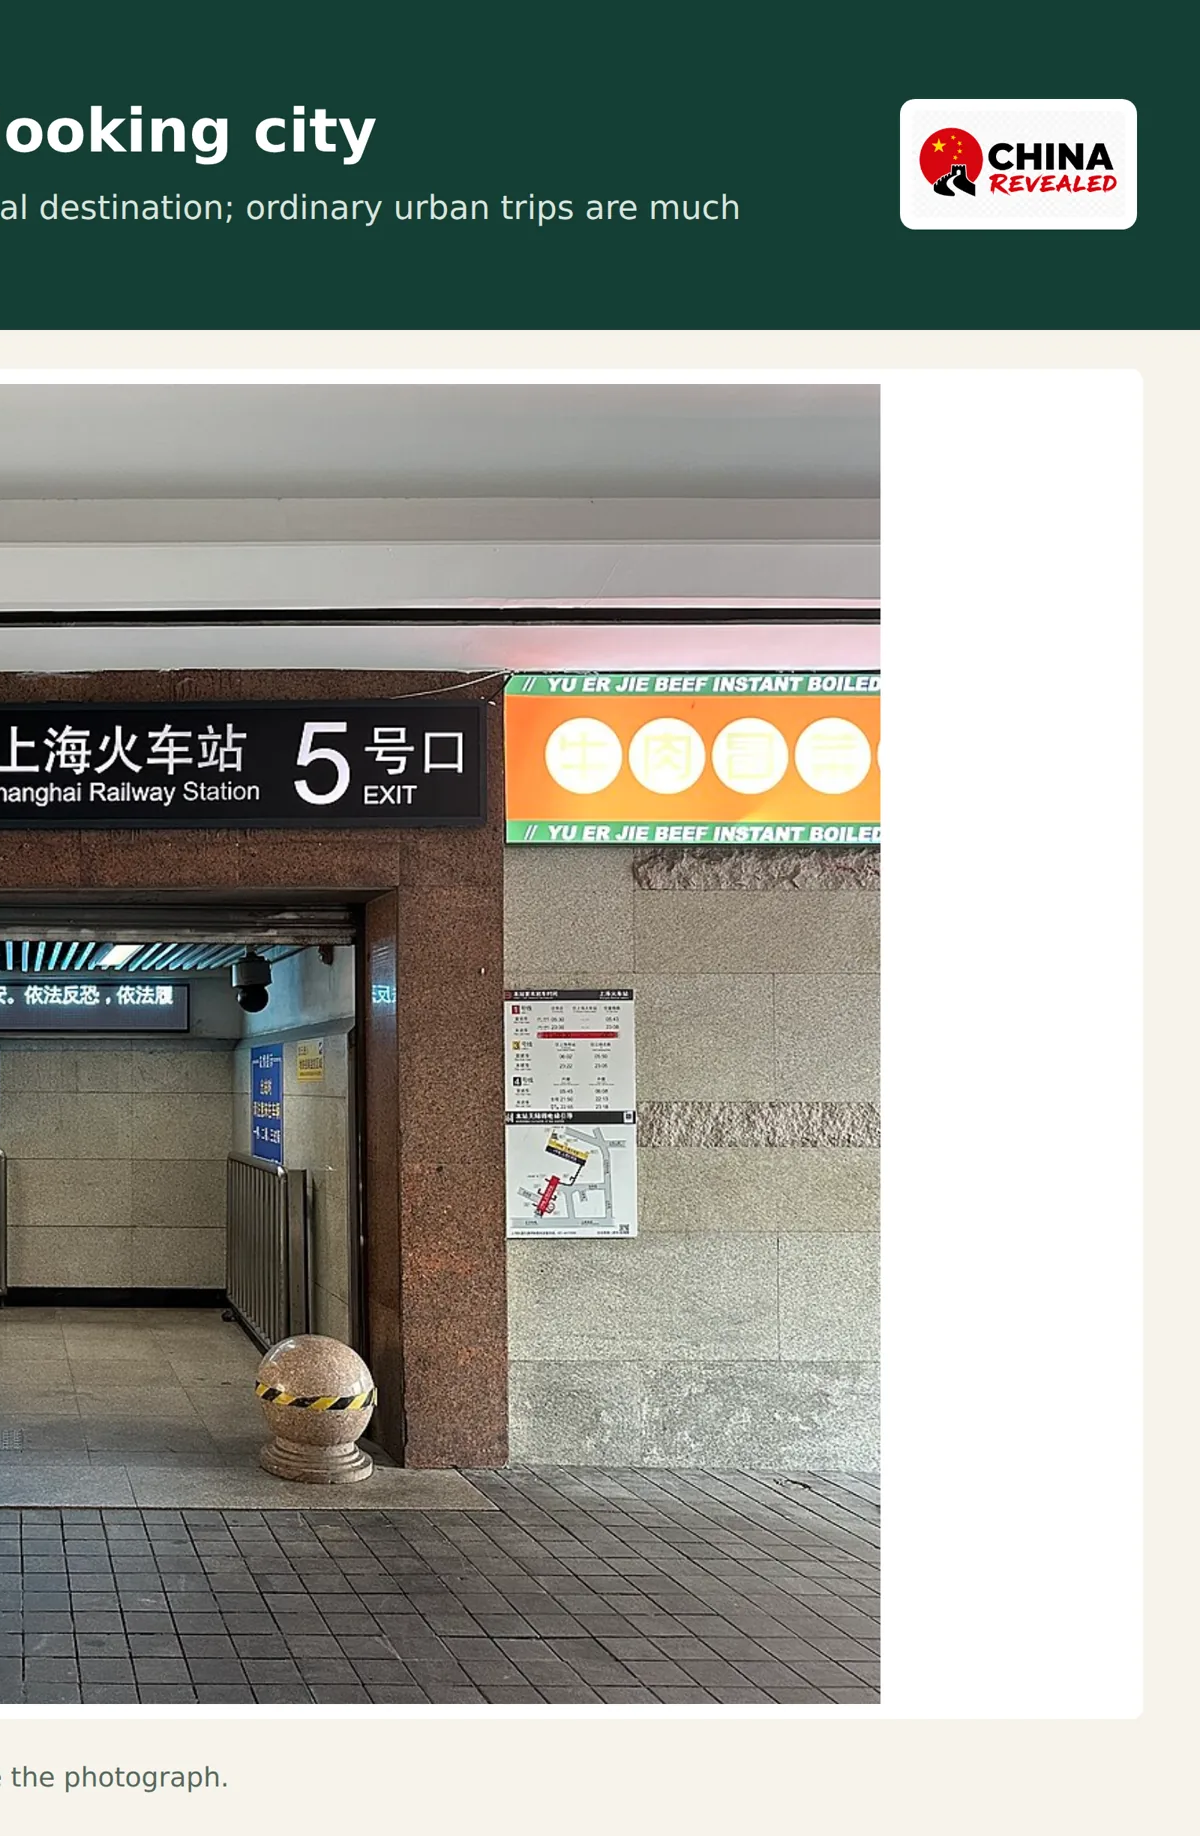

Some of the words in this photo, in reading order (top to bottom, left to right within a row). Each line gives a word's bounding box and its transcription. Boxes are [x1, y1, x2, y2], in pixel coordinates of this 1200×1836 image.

[548, 677, 577, 692] YU
[582, 677, 611, 692] ER
[615, 677, 650, 692] JIE
[655, 677, 708, 692] BEEF
[712, 676, 804, 692] INSTANT
[807, 676, 880, 692] BOILED
[294, 722, 350, 805] 5
[365, 727, 464, 775] 号口
[90, 782, 177, 806] Railway
[183, 781, 260, 802] Station
[364, 785, 417, 804] EXIT
[549, 825, 577, 841] YU
[582, 825, 611, 841] ER
[615, 825, 649, 841] JIE
[654, 826, 709, 841] BEEF
[713, 826, 806, 842] INSTANT
